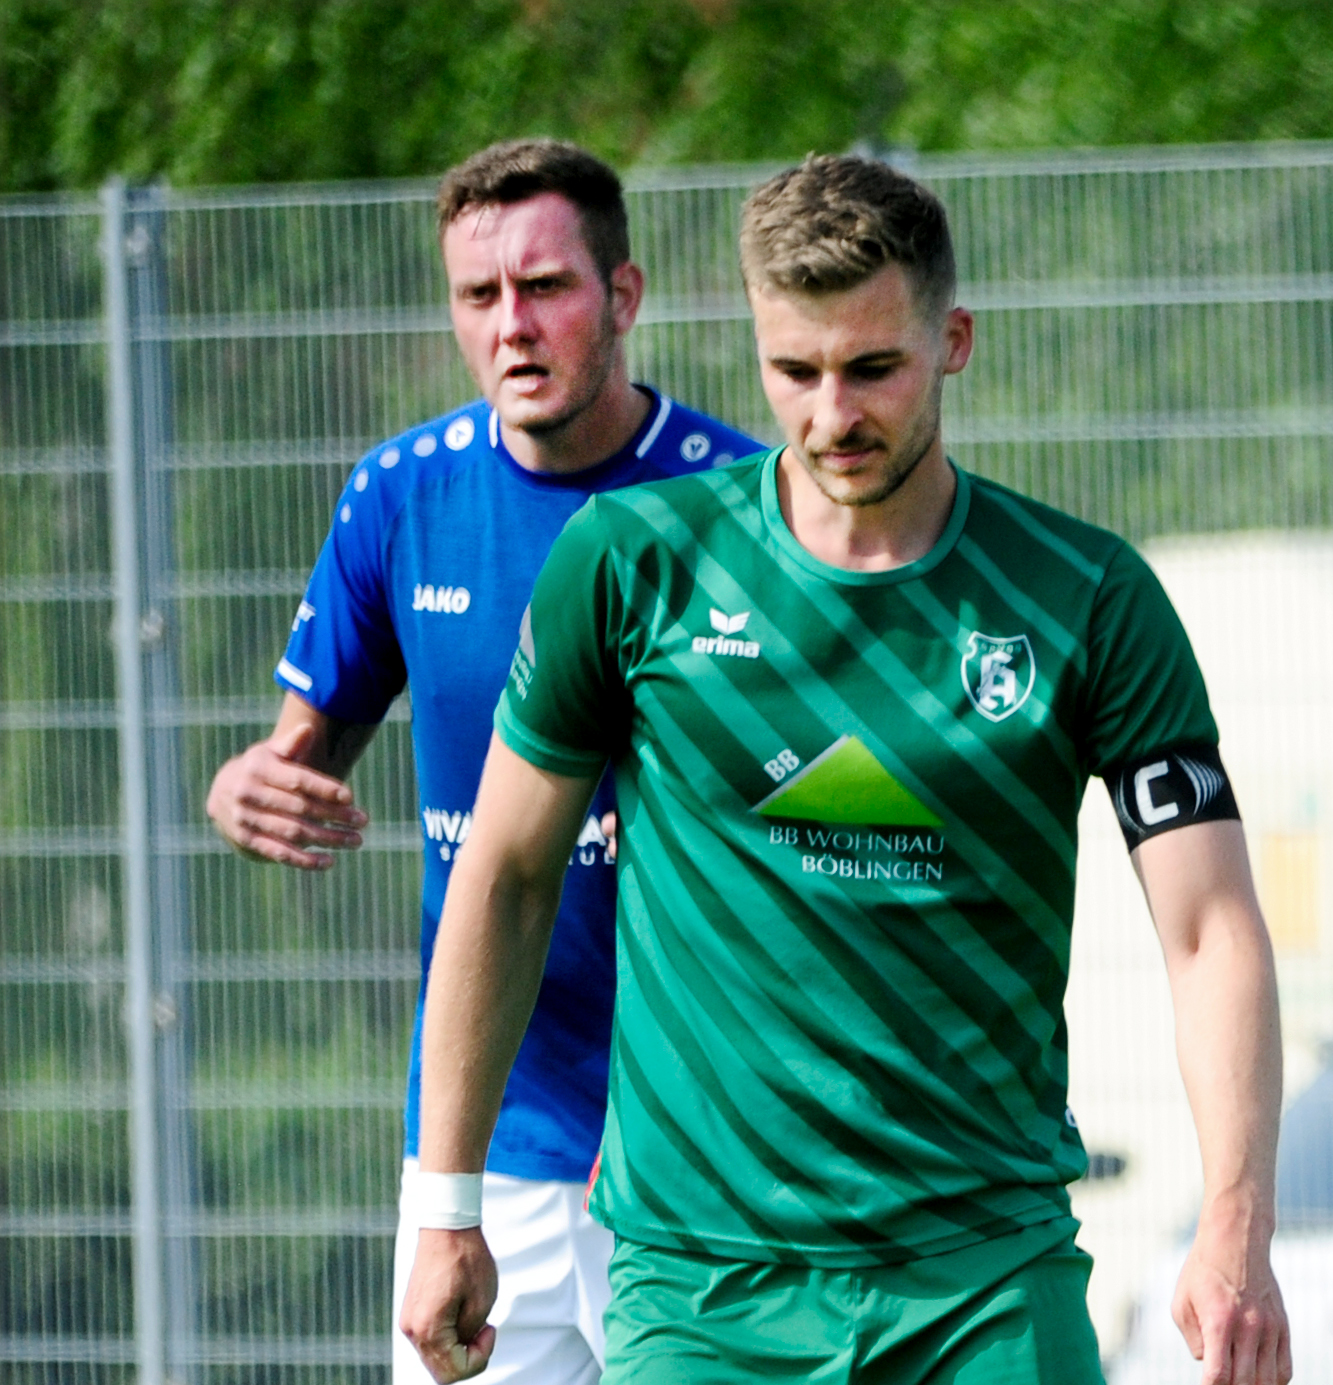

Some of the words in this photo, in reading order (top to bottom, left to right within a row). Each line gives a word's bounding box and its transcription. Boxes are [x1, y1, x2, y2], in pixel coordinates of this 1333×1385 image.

[413, 583, 470, 614] JAKO
[692, 635, 759, 658] erima
[764, 748, 799, 782] BB
[1134, 760, 1179, 826] C
[770, 826, 798, 845] BB
[807, 829, 944, 854] WOHNBAU
[802, 854, 943, 880] BÖBLINGEN
